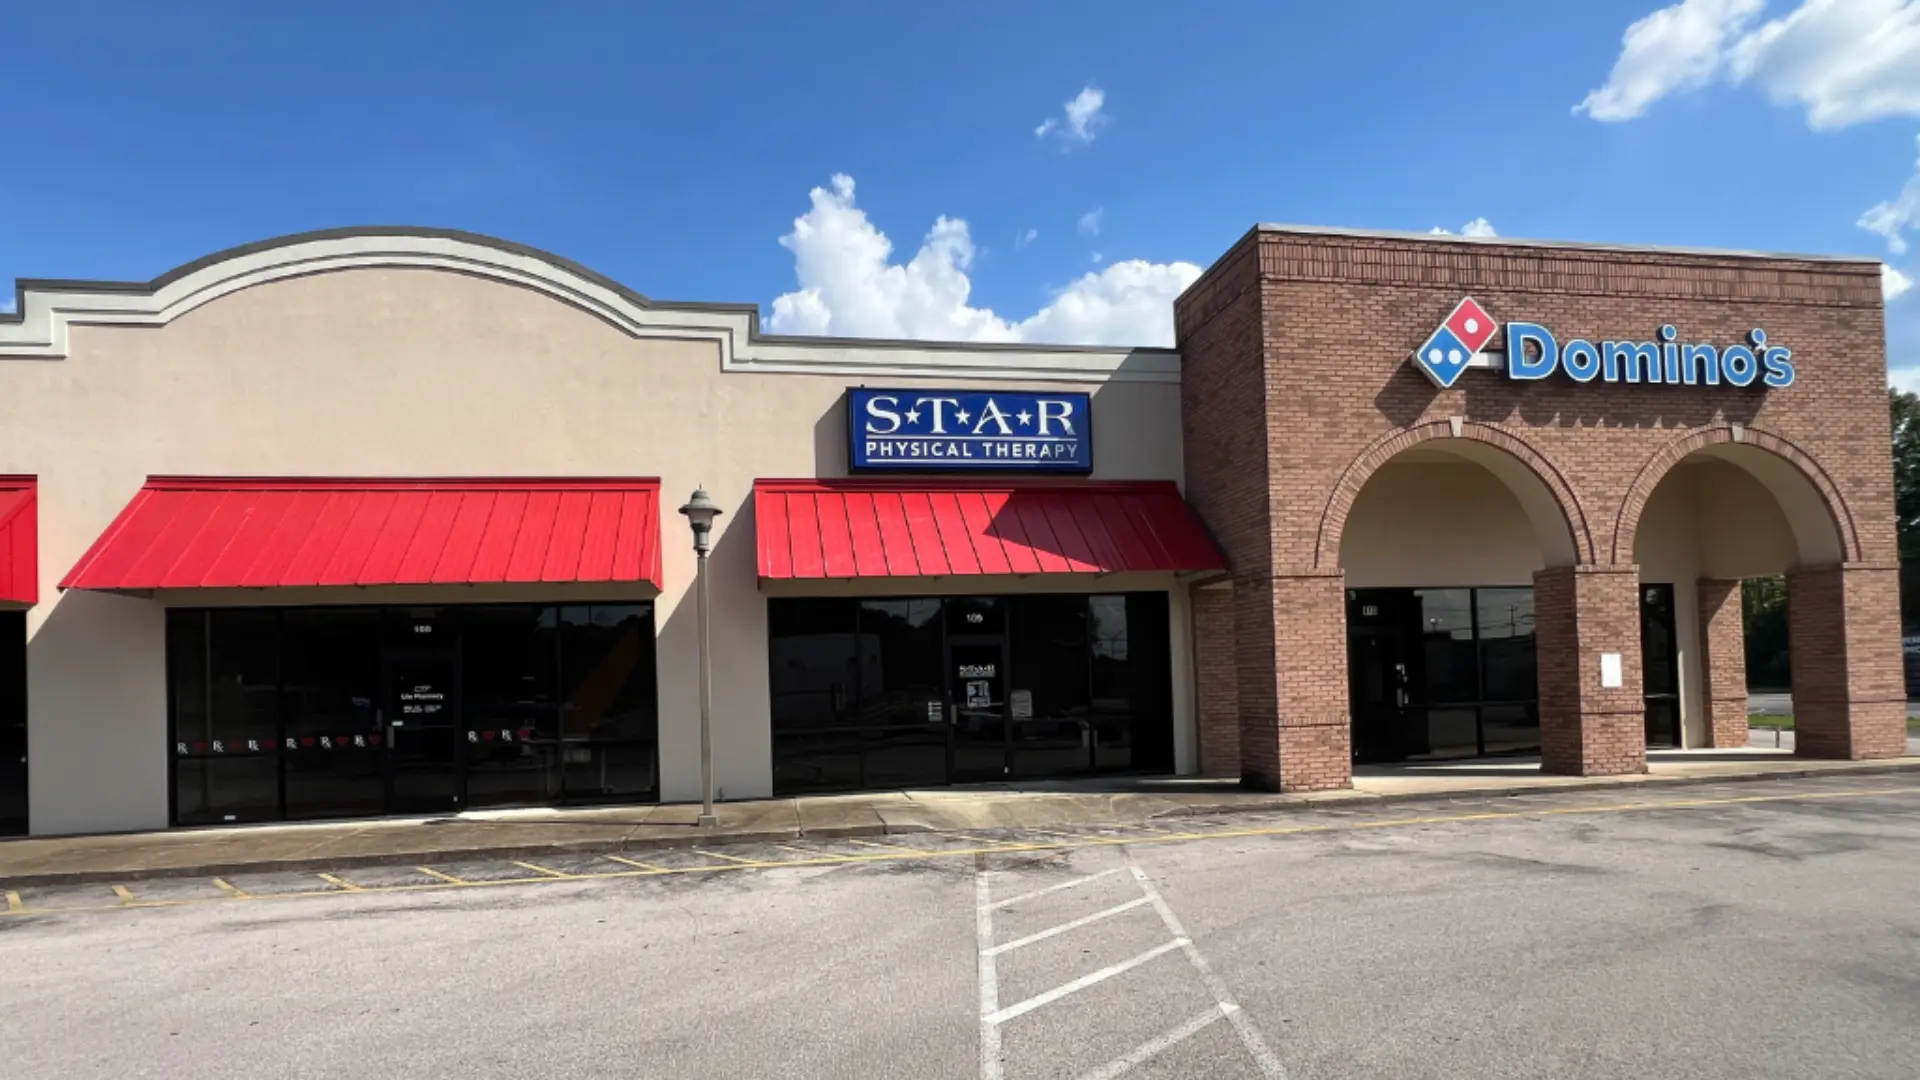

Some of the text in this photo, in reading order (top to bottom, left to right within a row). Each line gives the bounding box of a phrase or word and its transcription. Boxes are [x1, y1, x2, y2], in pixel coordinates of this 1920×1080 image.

[1506, 321, 1796, 388] Domino's
[866, 442, 1078, 459] PHYSICAL THERAPY
